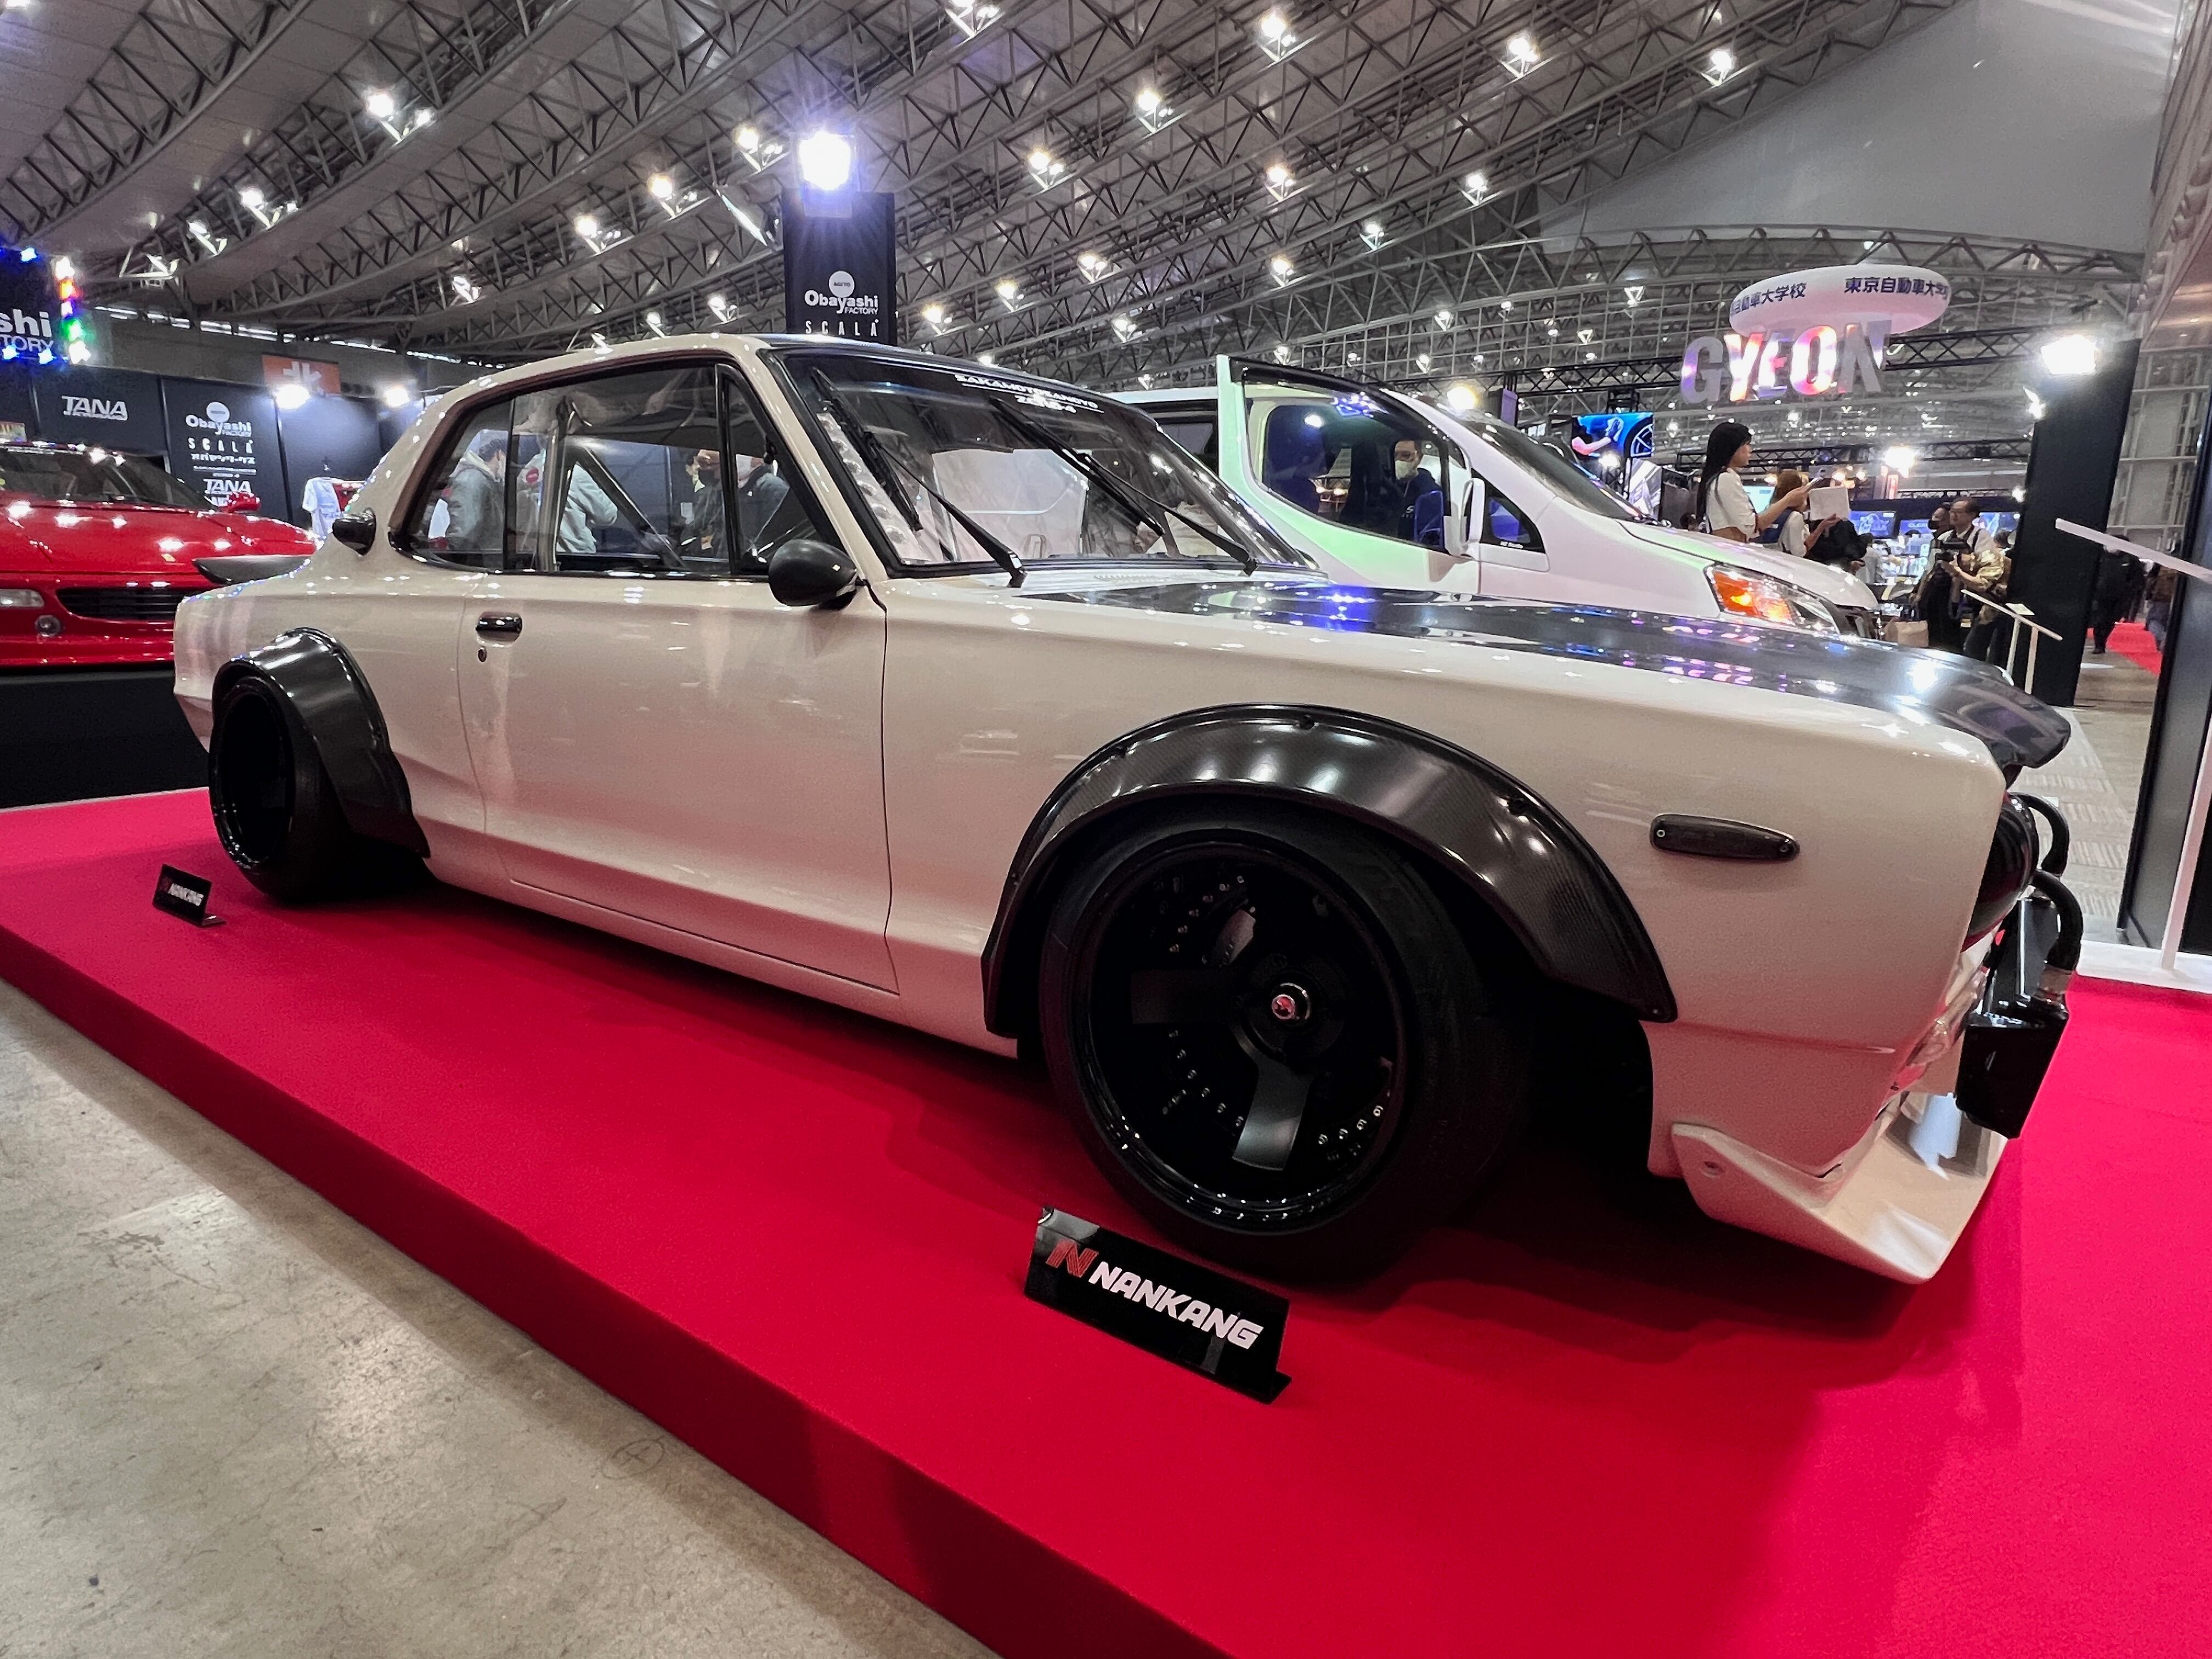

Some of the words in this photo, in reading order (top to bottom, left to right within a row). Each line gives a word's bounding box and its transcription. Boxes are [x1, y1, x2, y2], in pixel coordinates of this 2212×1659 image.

[804, 290, 878, 314] Obayashi
[844, 306, 878, 315] FACTORY
[1680, 320, 1893, 404] GYEON
[185, 415, 252, 435] Obayashi
[1088, 1261, 1263, 1349] NANKANG
